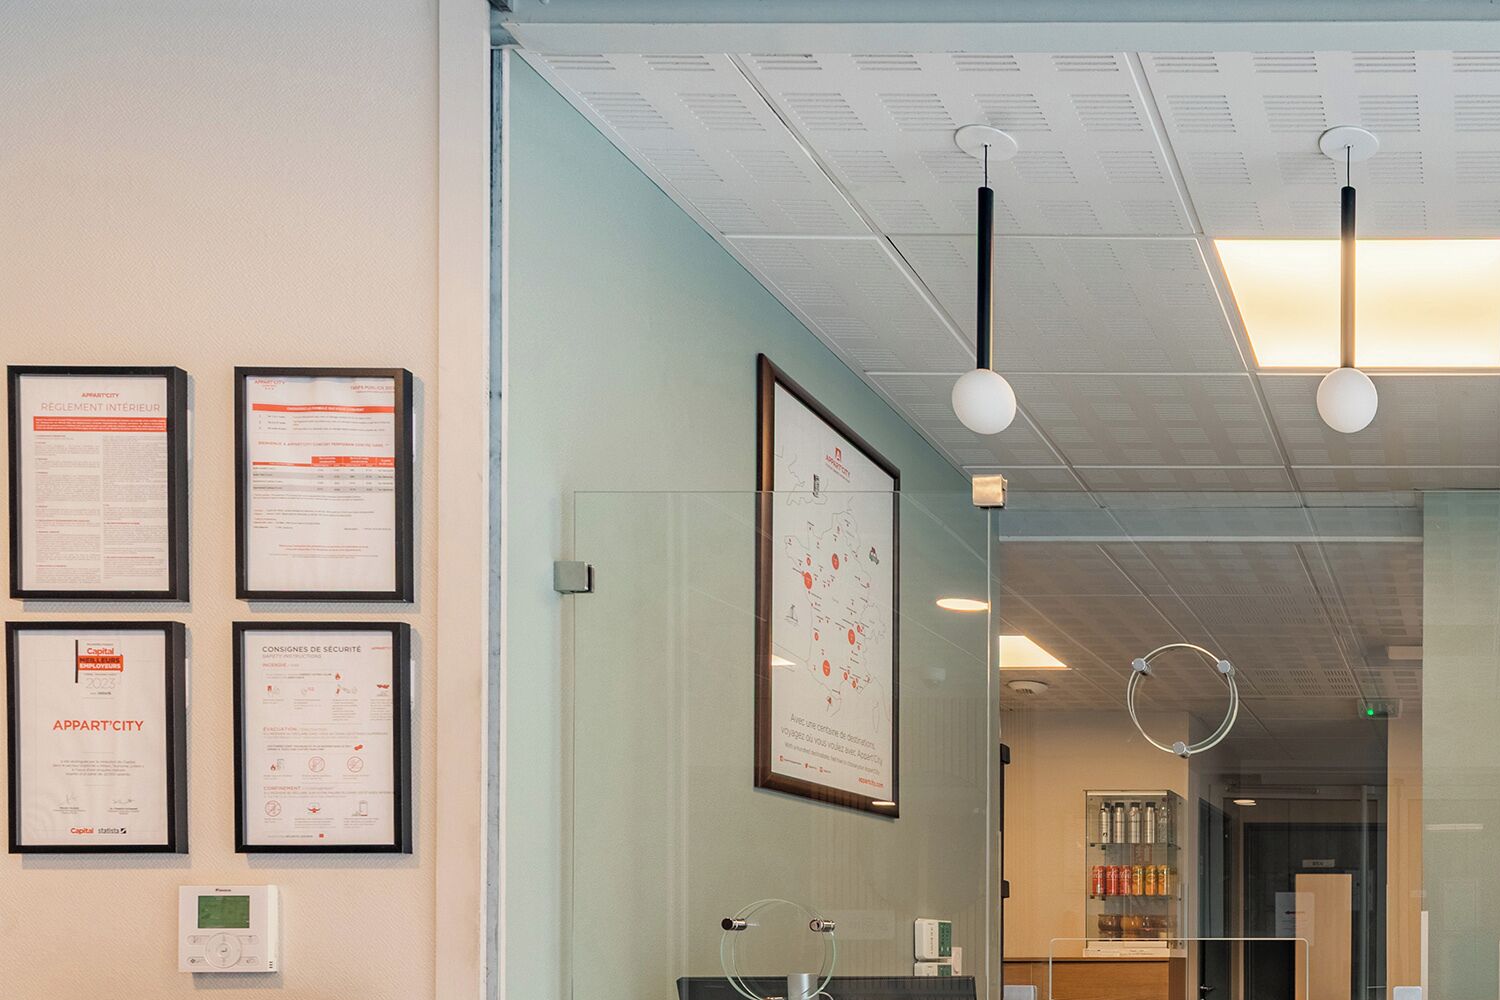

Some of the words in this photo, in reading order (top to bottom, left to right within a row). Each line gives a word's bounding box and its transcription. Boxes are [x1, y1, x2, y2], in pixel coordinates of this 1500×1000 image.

[105, 402, 161, 412] INTÉRIEUR
[87, 647, 115, 657] Capital
[323, 644, 362, 653] SÉCURITÉ
[53, 719, 144, 731] APPART'CITY
[70, 827, 94, 835] Capital
